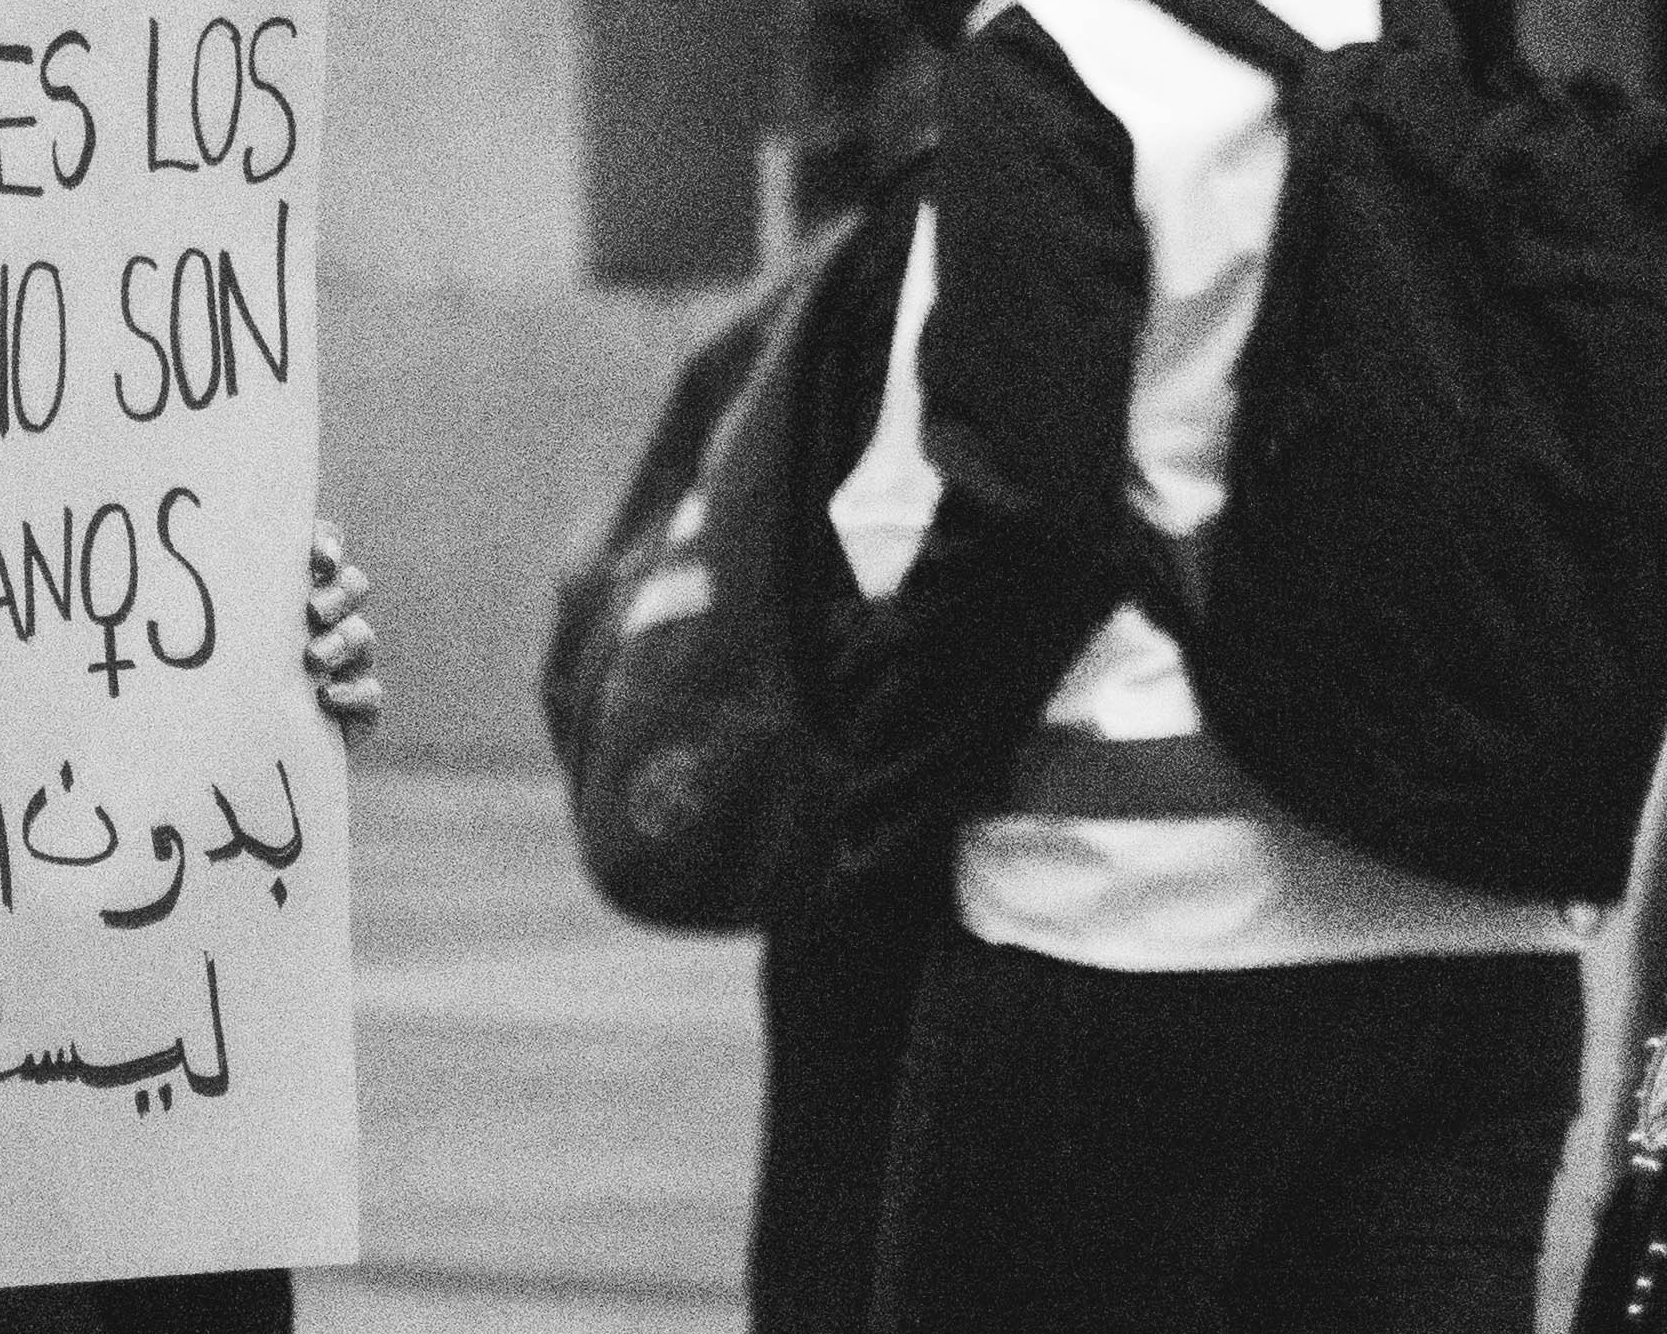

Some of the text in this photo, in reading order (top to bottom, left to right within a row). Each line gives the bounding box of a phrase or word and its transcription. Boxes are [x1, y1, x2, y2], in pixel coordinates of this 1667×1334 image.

[146, 16, 297, 184] LOS
[114, 199, 289, 422] SON
[23, 759, 304, 929] بدون
